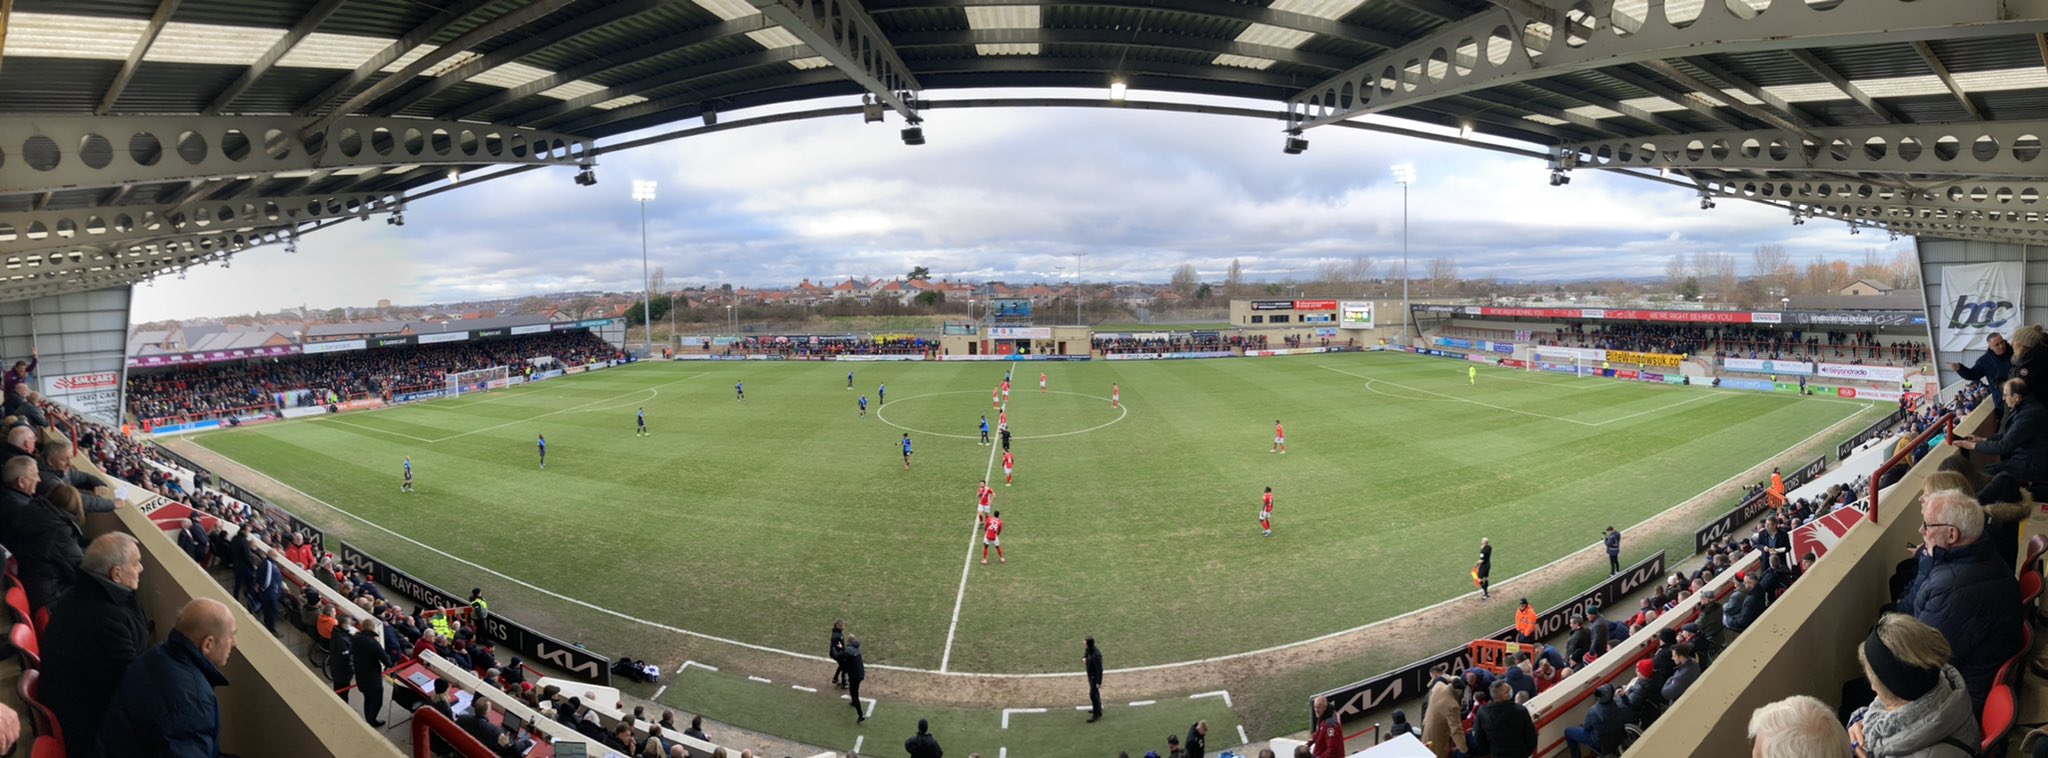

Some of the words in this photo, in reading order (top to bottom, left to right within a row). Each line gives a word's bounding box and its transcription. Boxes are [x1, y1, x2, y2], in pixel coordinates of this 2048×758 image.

[1670, 312, 1688, 320] RIGHT
[1690, 313, 1715, 321] BEHIND
[1830, 367, 1867, 376] beyondradio
[1535, 593, 1602, 642] MOTORS
